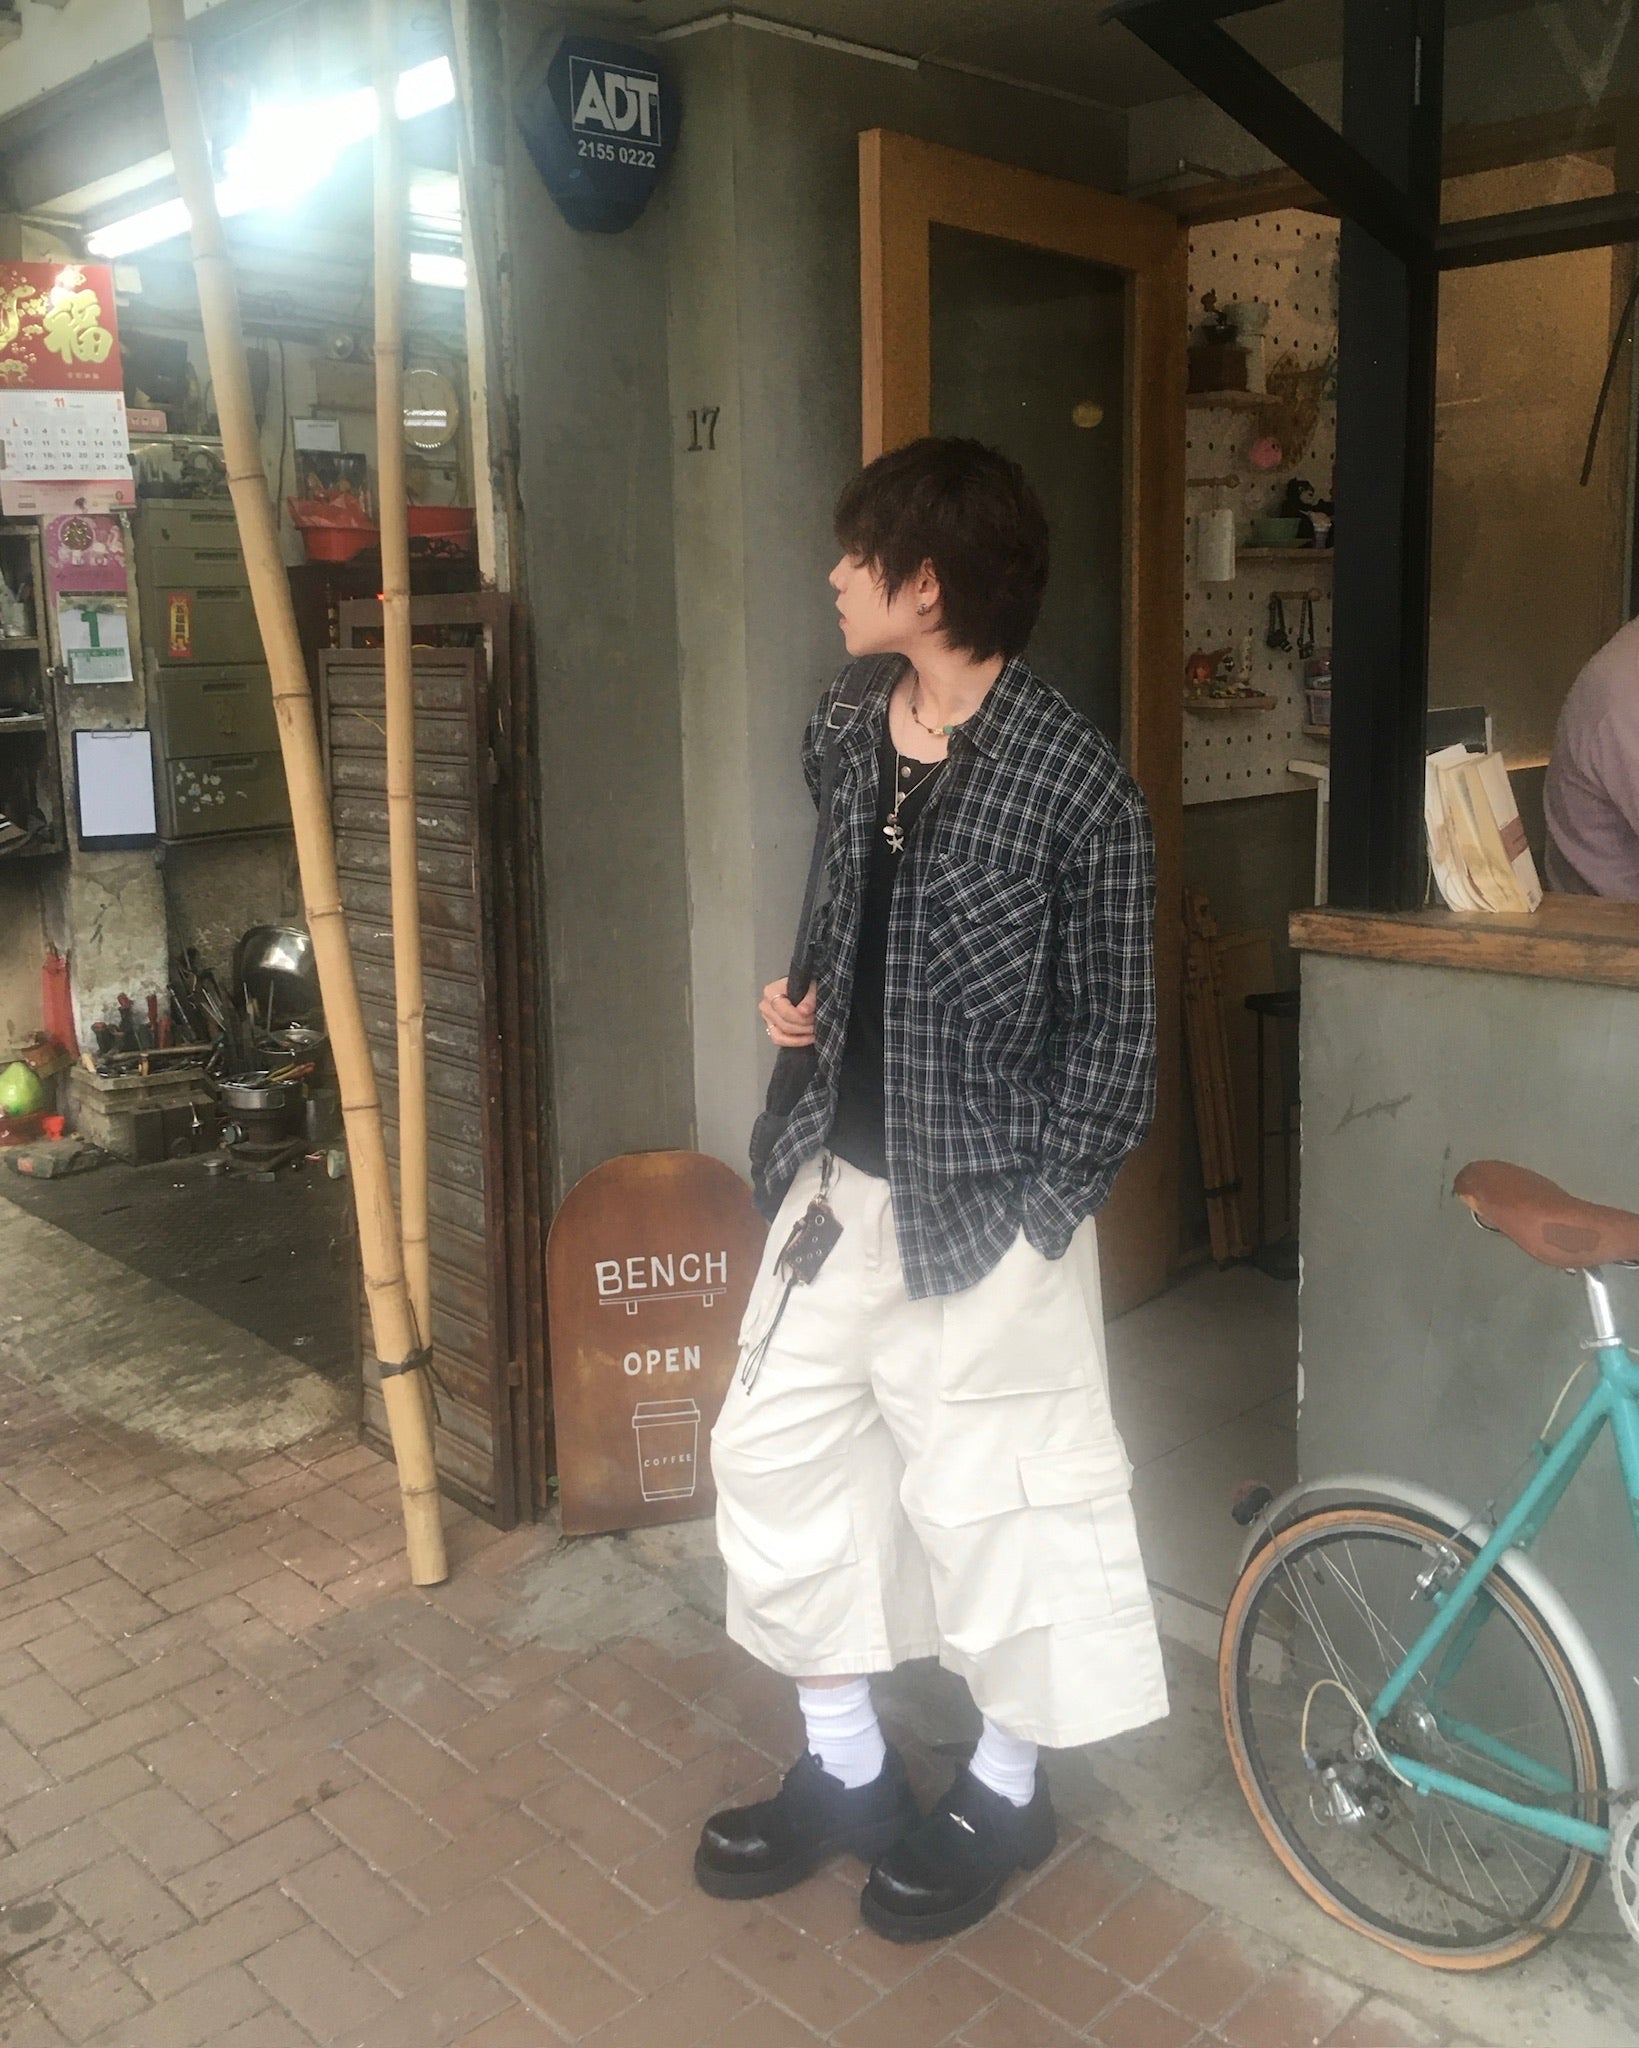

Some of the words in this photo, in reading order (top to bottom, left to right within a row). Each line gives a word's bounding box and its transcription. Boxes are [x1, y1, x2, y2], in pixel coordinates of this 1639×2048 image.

[574, 69, 659, 137] ADT
[578, 139, 615, 162] 2155
[618, 147, 656, 169] 0222
[43, 286, 113, 365] 福
[54, 397, 65, 408] 11
[687, 406, 720, 452] 17
[81, 612, 100, 648] 1
[595, 1251, 728, 1296] BENCH
[623, 1345, 701, 1376] OPEN
[643, 1453, 693, 1468] COFFEE
